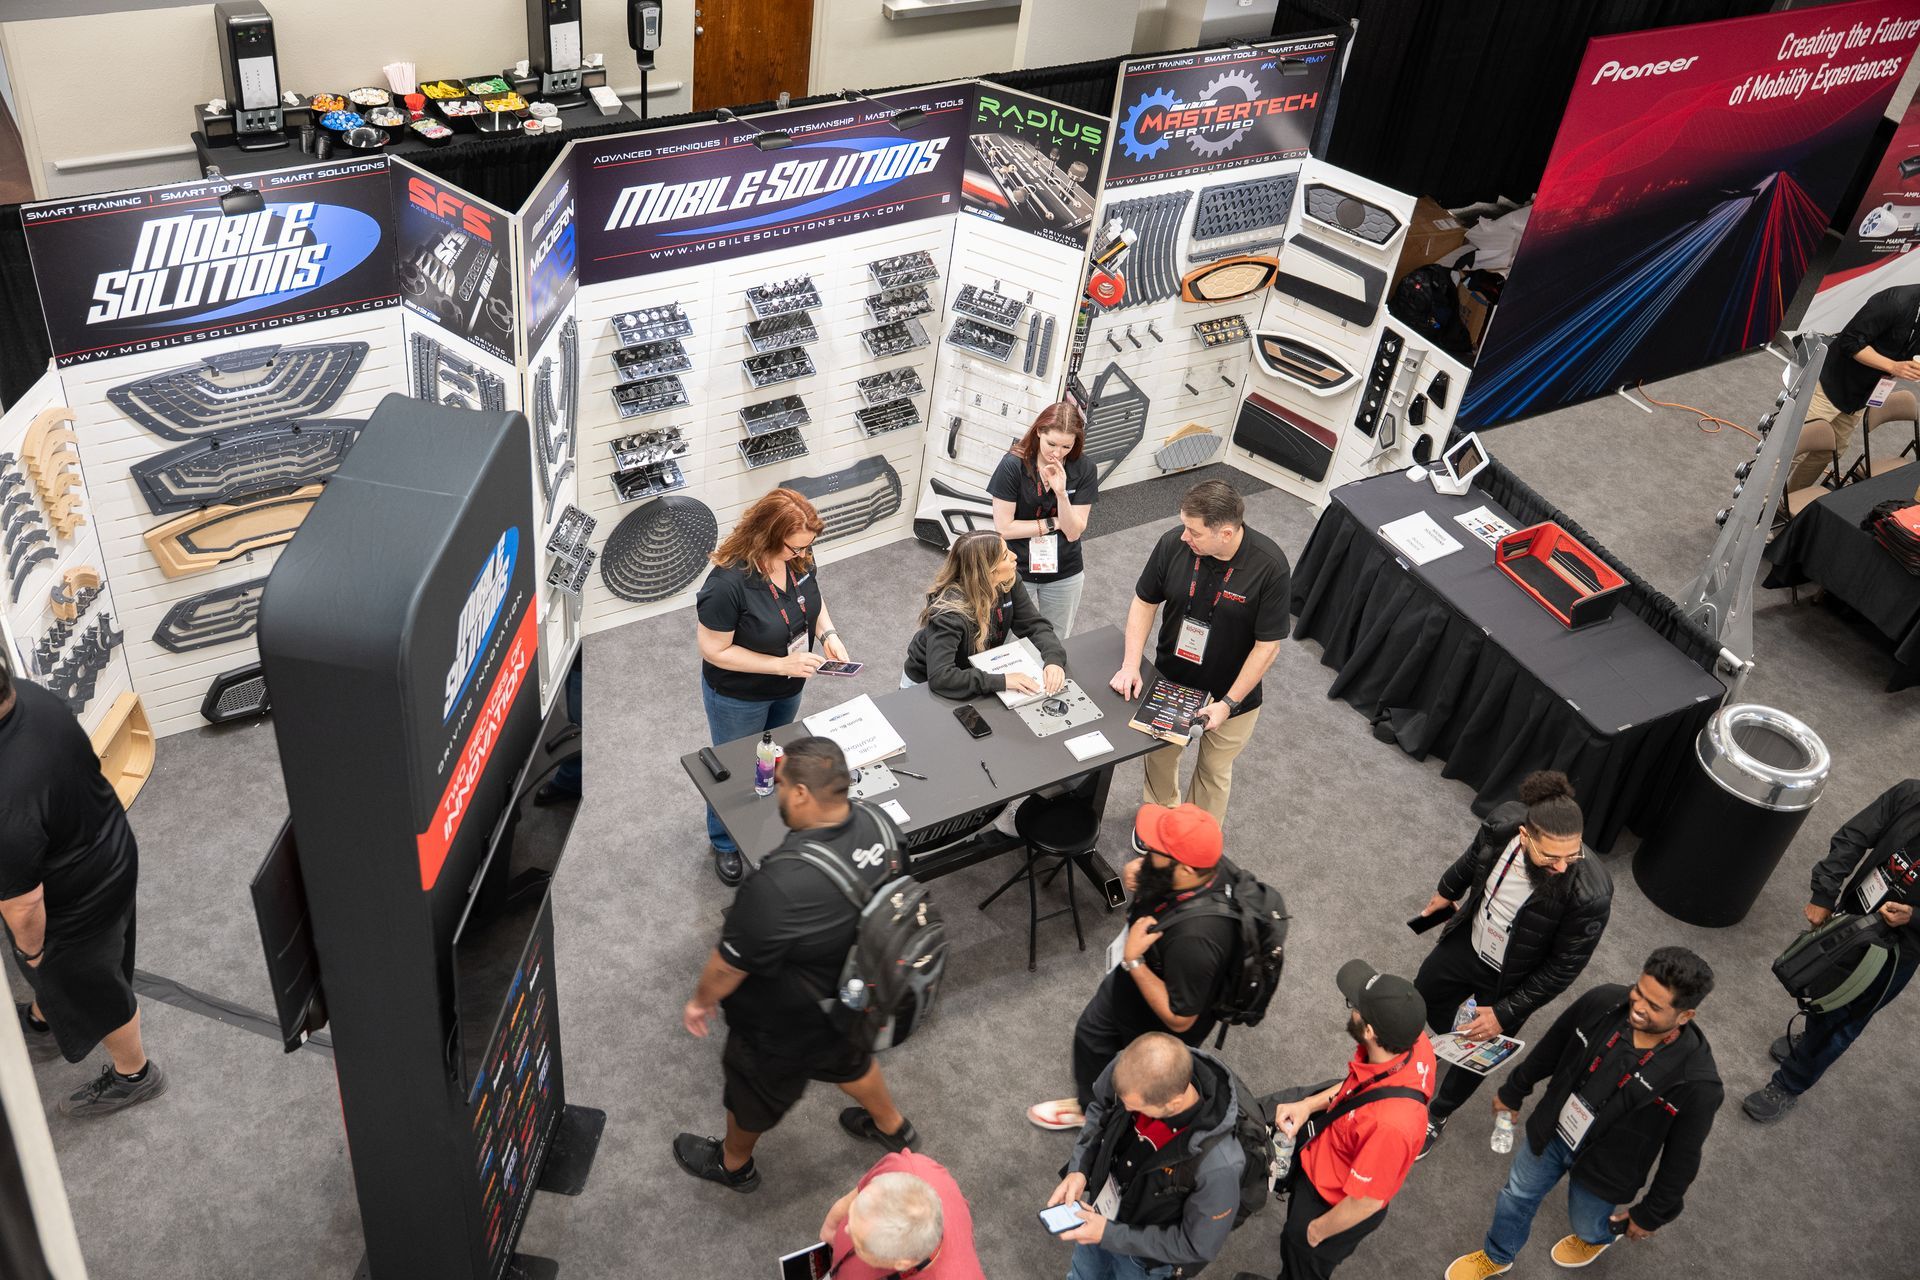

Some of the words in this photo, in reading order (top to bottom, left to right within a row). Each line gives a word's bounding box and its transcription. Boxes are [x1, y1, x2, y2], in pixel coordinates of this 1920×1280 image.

[1128, 63, 1156, 73] SMART
[1158, 58, 1194, 68] TRAINING
[1204, 54, 1232, 63] SMART
[1232, 50, 1257, 59] TOOLS
[1293, 40, 1335, 52] SOLUTIONS
[1777, 26, 1842, 61] Creating
[1845, 21, 1869, 49] the
[1870, 16, 1920, 45] Future
[1592, 55, 1699, 85] Pioneer
[1728, 77, 1753, 106] of
[1748, 68, 1811, 102] Mobility
[1810, 55, 1902, 95] Experiences
[593, 150, 652, 164] ADVANCED
[656, 139, 721, 154] TECHNIQUES
[935, 98, 964, 109] TOOLS
[979, 96, 1102, 145] RADIUS
[1139, 92, 1319, 134] MASTERTECH
[1163, 119, 1254, 140] CERTIFIED
[26, 207, 75, 220] SMART
[79, 197, 141, 213] TRAINING
[160, 188, 207, 202] SMART
[270, 172, 315, 185] SMART
[317, 161, 385, 178] SOLUTIONS
[1104, 150, 1308, 188] WWW.MOBILESOLUTIONS-USA.COM
[409, 177, 492, 242] SFS
[650, 204, 905, 259] WWW.MOBILESOLUTIONS-USA.COM
[131, 202, 316, 273] MOBILE
[530, 199, 575, 277] MODERN
[1033, 230, 1084, 250] INNOVATION
[1042, 228, 1077, 243] DRIVING
[86, 243, 329, 325] SOLUTIONS
[60, 298, 399, 366] WWW.MOBILESOLUTIONS-USA.COM
[467, 336, 514, 364] INNOVATION
[474, 335, 506, 355] DRIVING
[437, 698, 473, 775] DRIVING
[475, 590, 523, 691] INNOVATION
[444, 762, 467, 811] TWO
[468, 668, 509, 759] DECADES
[511, 637, 523, 666] OF
[444, 651, 525, 840] INNOVATION
